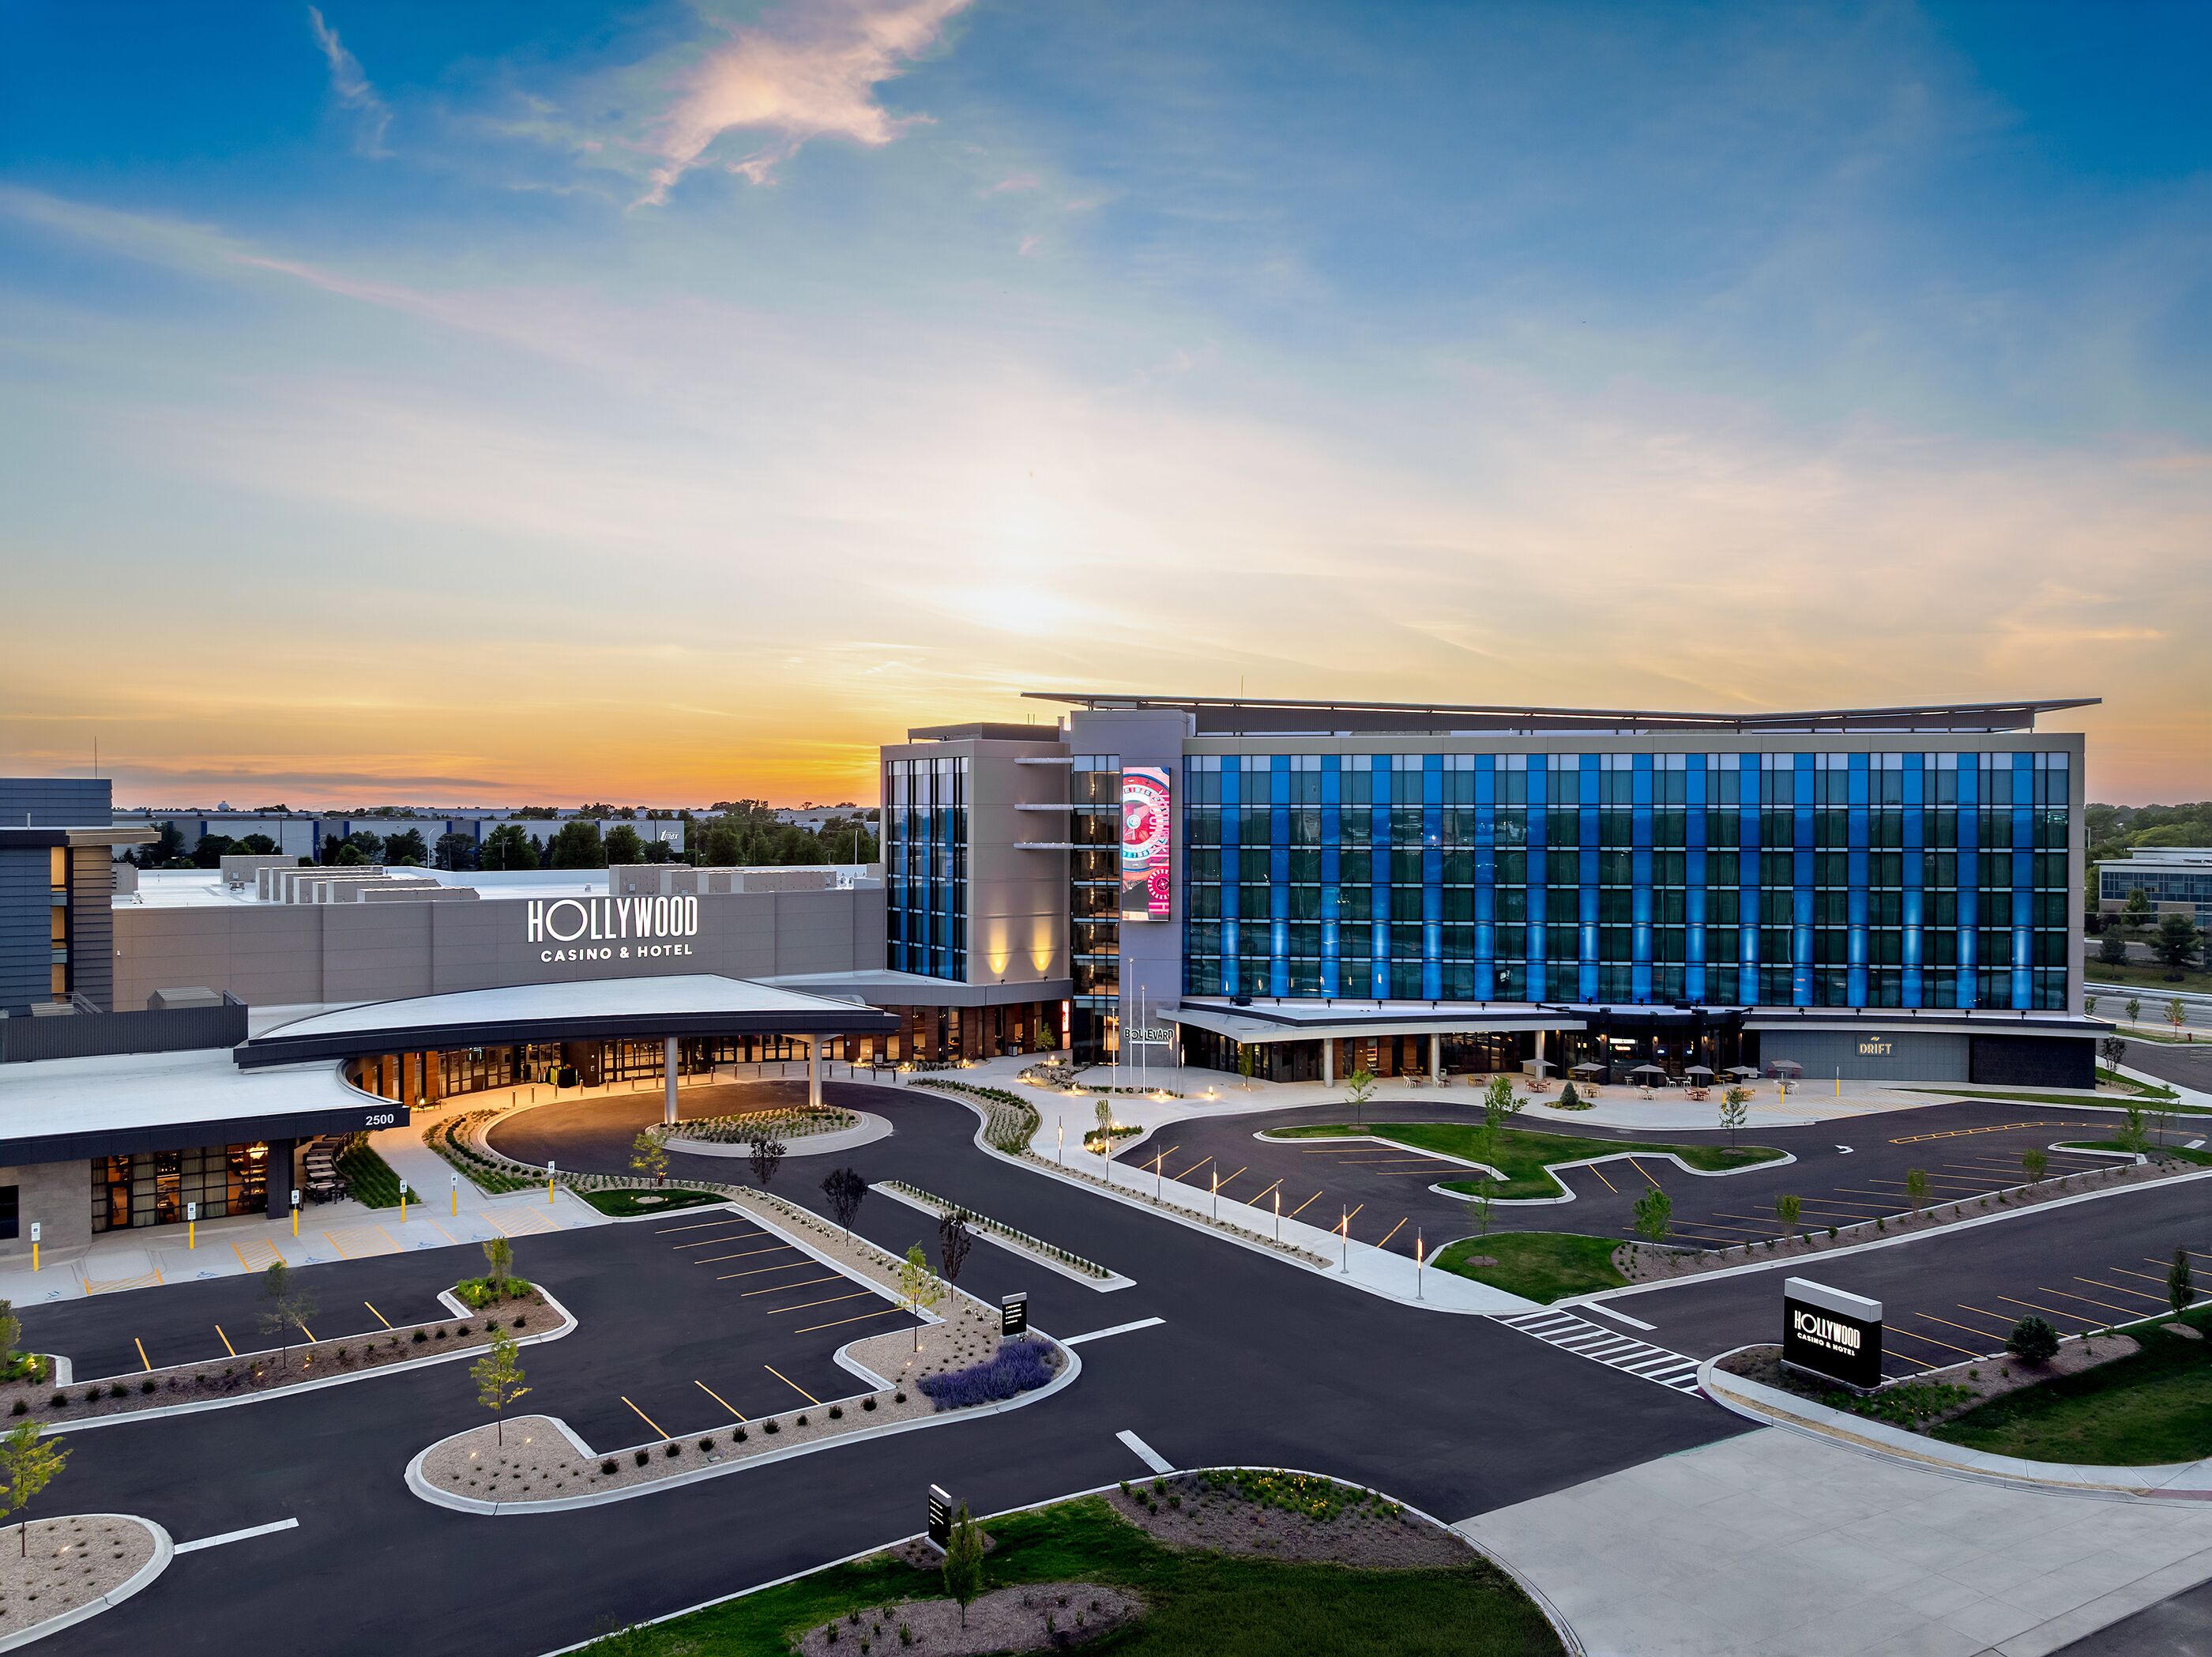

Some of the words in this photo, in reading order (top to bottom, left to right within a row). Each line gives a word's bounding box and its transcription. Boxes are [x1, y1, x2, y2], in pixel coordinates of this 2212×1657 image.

[527, 895, 698, 943] HOLLYWOOD
[540, 947, 612, 962] CASINO
[619, 947, 630, 959] &
[637, 943, 694, 958] HOTEL
[1125, 1028, 1174, 1041] BOULEVARD
[1859, 1043, 1892, 1055] DRIFT
[365, 1113, 394, 1126] 2500
[1794, 1310, 1860, 1349] HOLLYWOOD
[1796, 1332, 1825, 1346] CASINO
[1832, 1344, 1856, 1357] HOTEL
